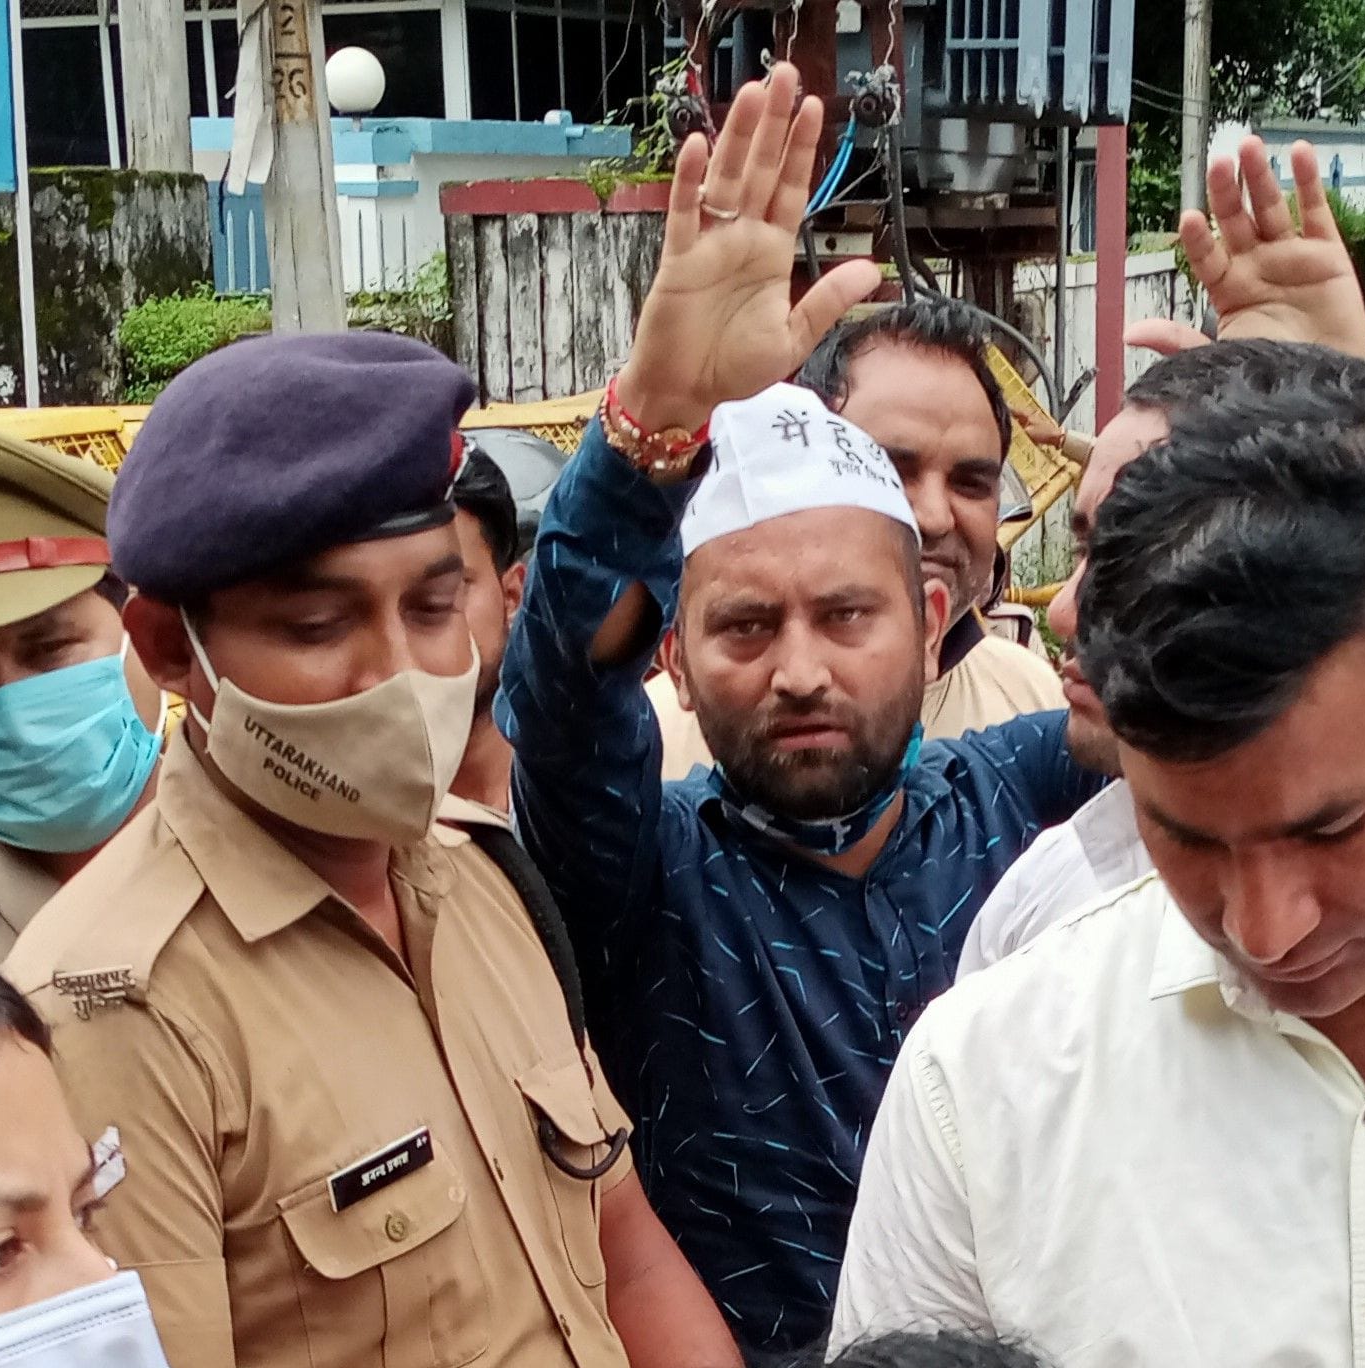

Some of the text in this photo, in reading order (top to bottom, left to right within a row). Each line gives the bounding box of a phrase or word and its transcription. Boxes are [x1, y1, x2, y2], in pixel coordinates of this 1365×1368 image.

[772, 409, 810, 448] मैं
[827, 420, 863, 465] हू
[244, 715, 361, 803] UTTARAKHAND
[263, 756, 322, 801] POLICE
